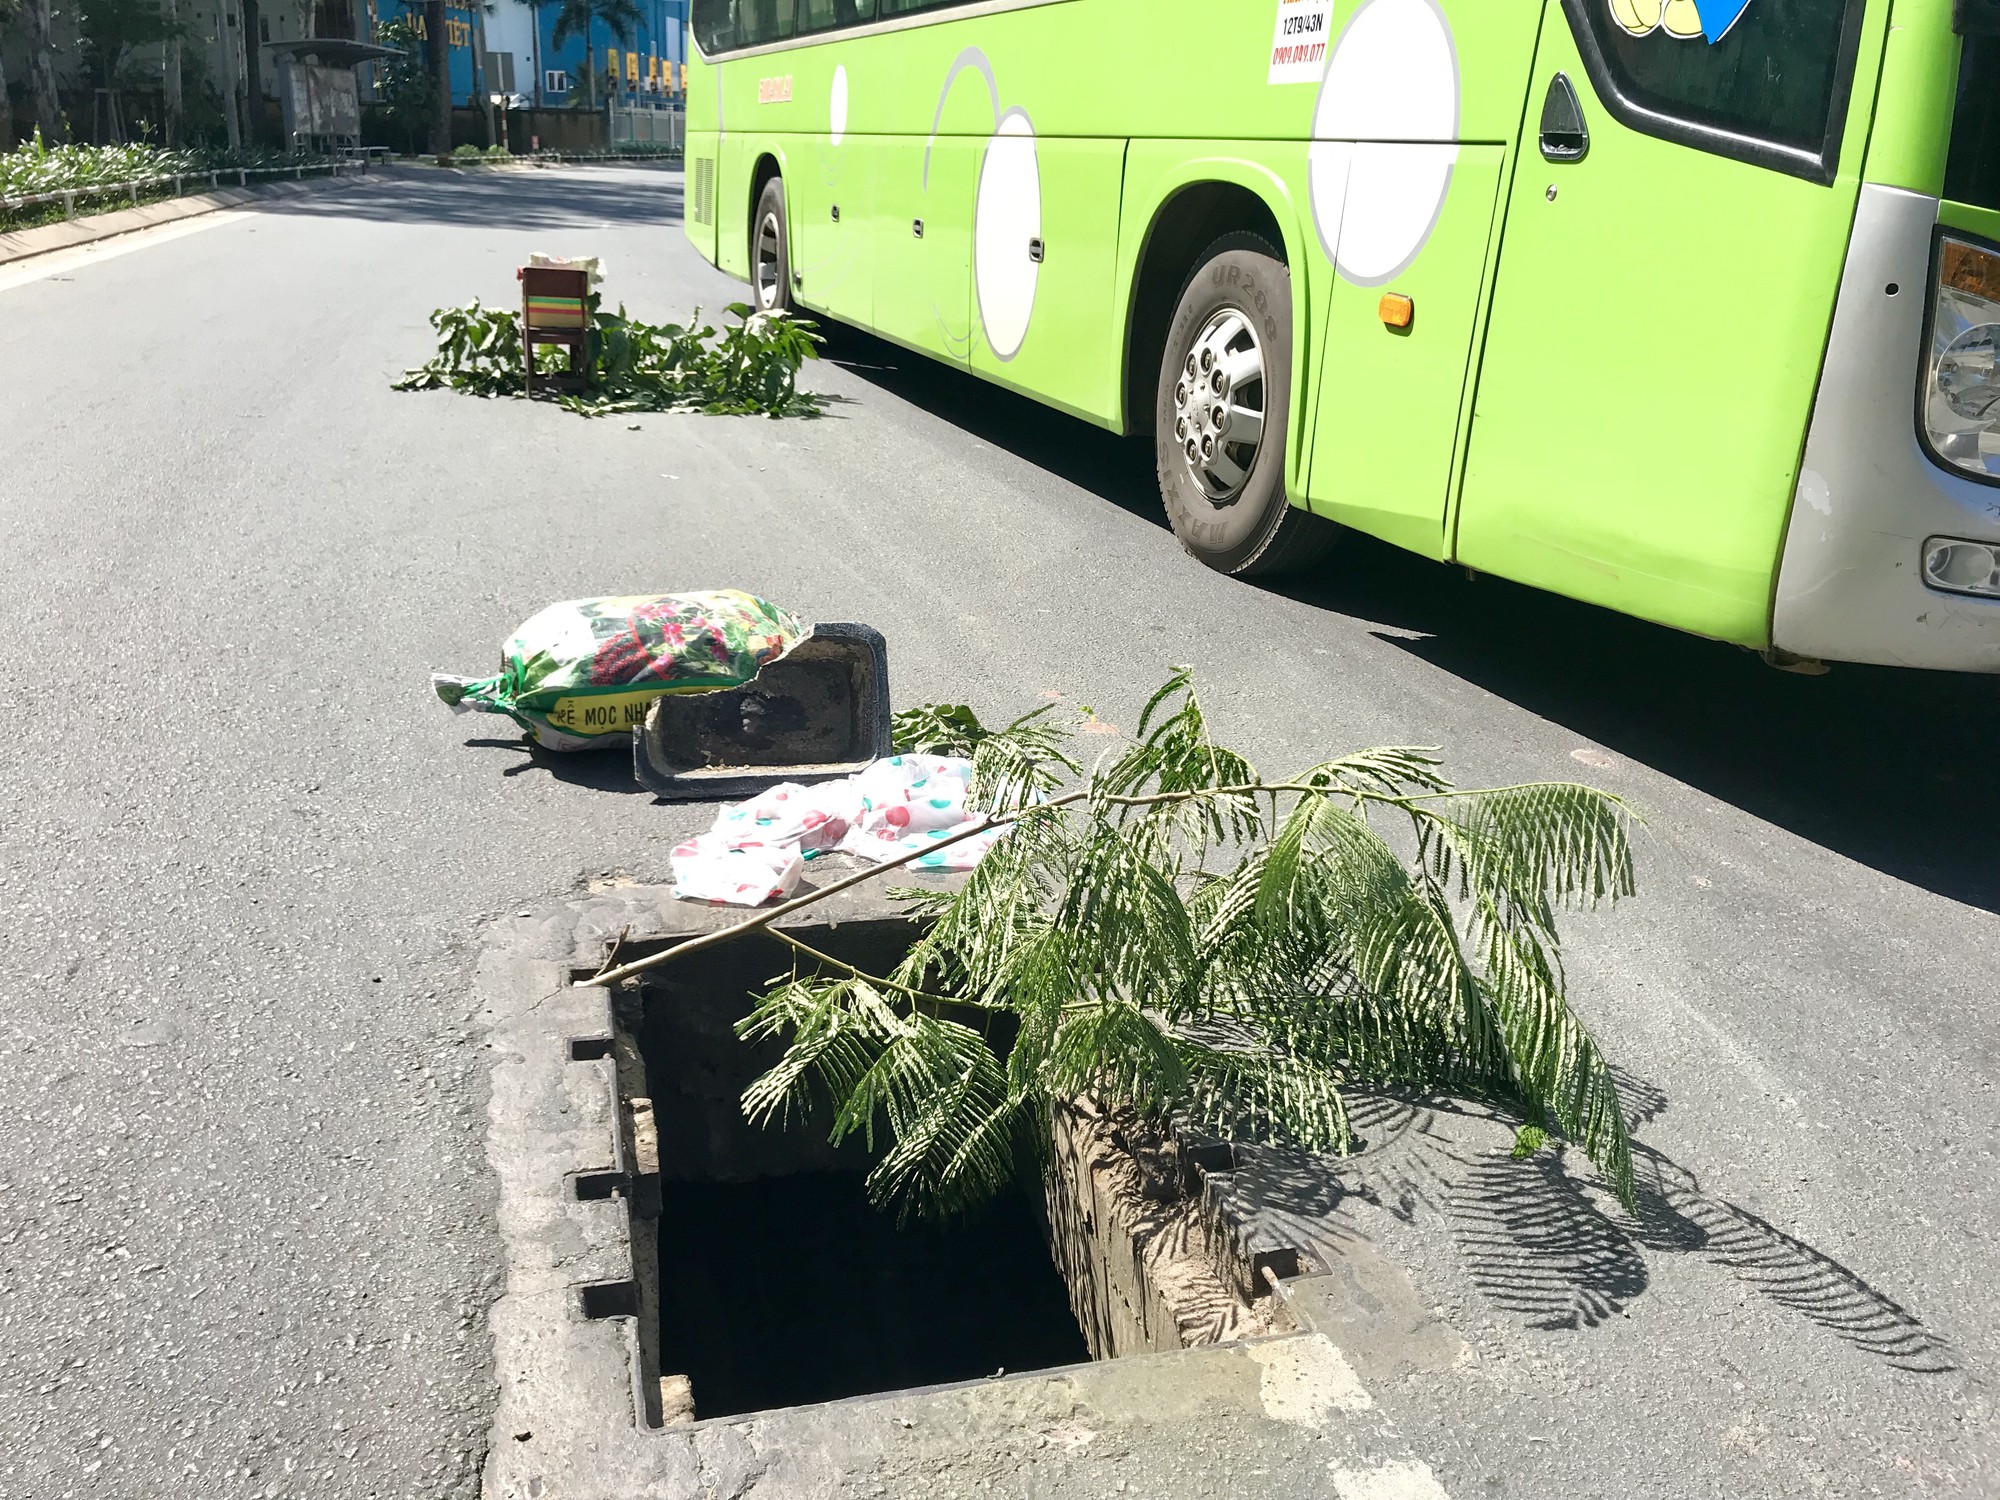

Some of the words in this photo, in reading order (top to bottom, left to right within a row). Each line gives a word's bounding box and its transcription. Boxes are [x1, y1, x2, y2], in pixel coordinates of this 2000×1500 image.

[1283, 12, 1324, 36] 12T9/43N
[1211, 264, 1277, 343] UR288
[1160, 441, 1229, 545] MAXXIS
[584, 705, 617, 729] MỌC
